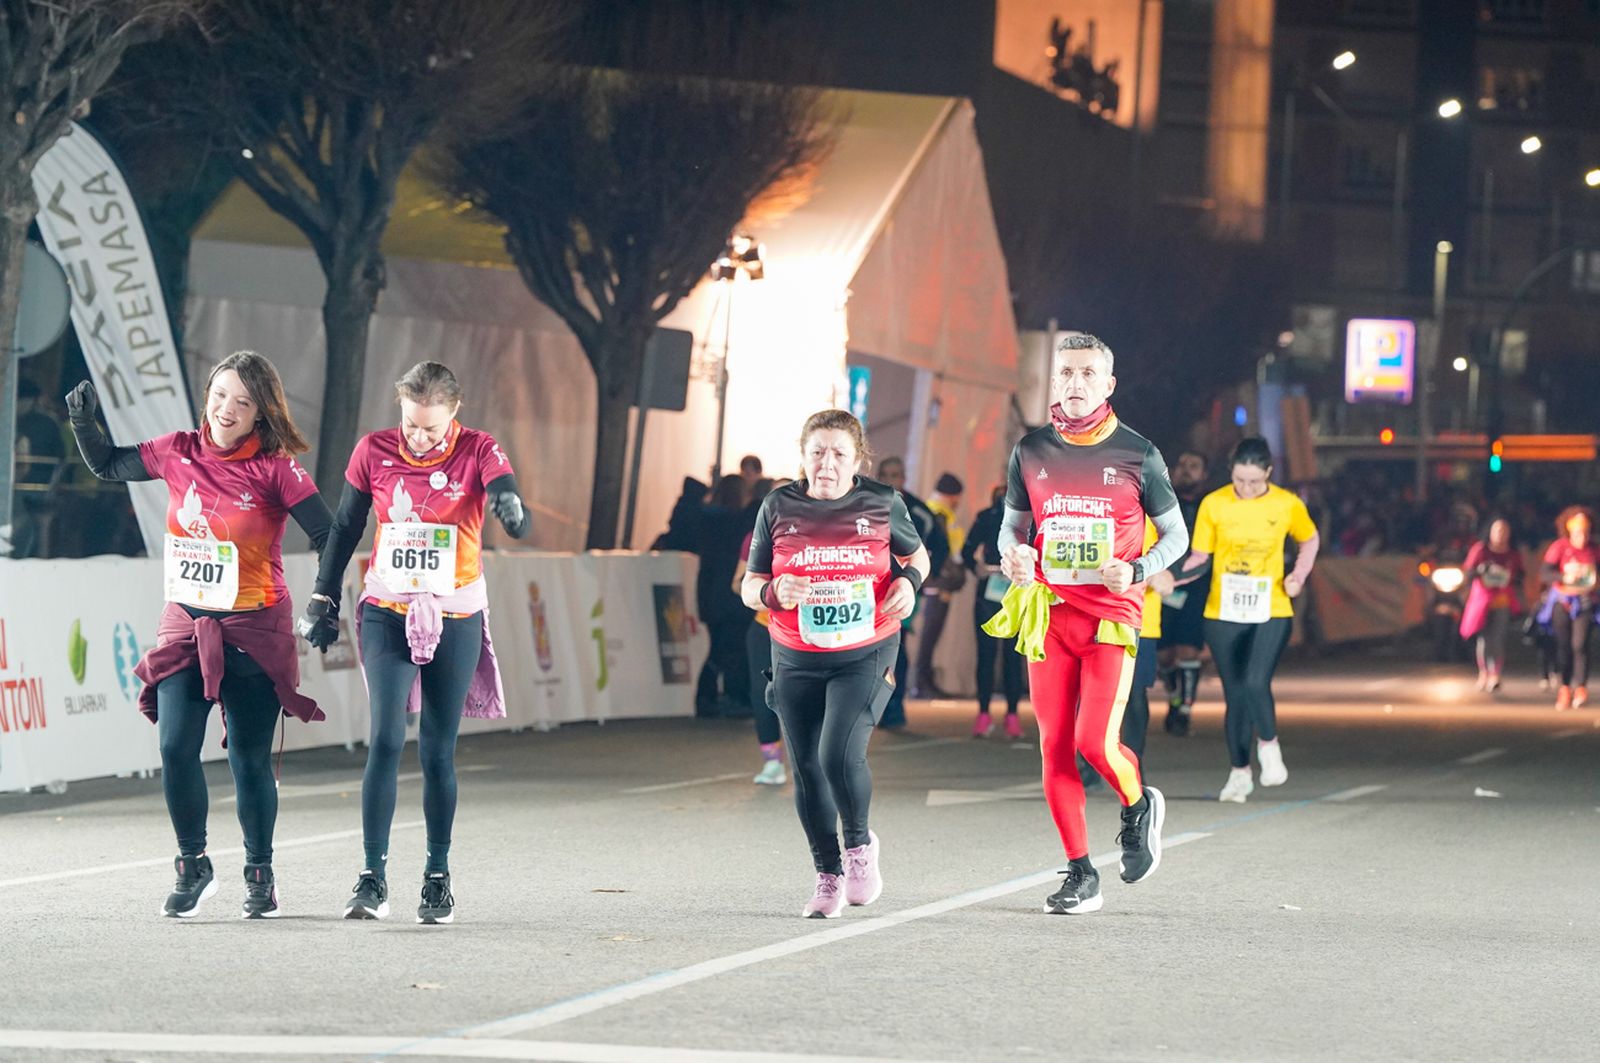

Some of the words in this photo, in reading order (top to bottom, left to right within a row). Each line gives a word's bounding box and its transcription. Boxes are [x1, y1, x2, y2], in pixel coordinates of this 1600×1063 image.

[82, 171, 176, 397] JAPEMASA
[188, 520, 208, 540] 43
[392, 548, 440, 570] 6615
[180, 560, 224, 584] 2207
[806, 596, 821, 605] SAN
[1233, 593, 1259, 606] 6117
[813, 602, 862, 626] 9292
